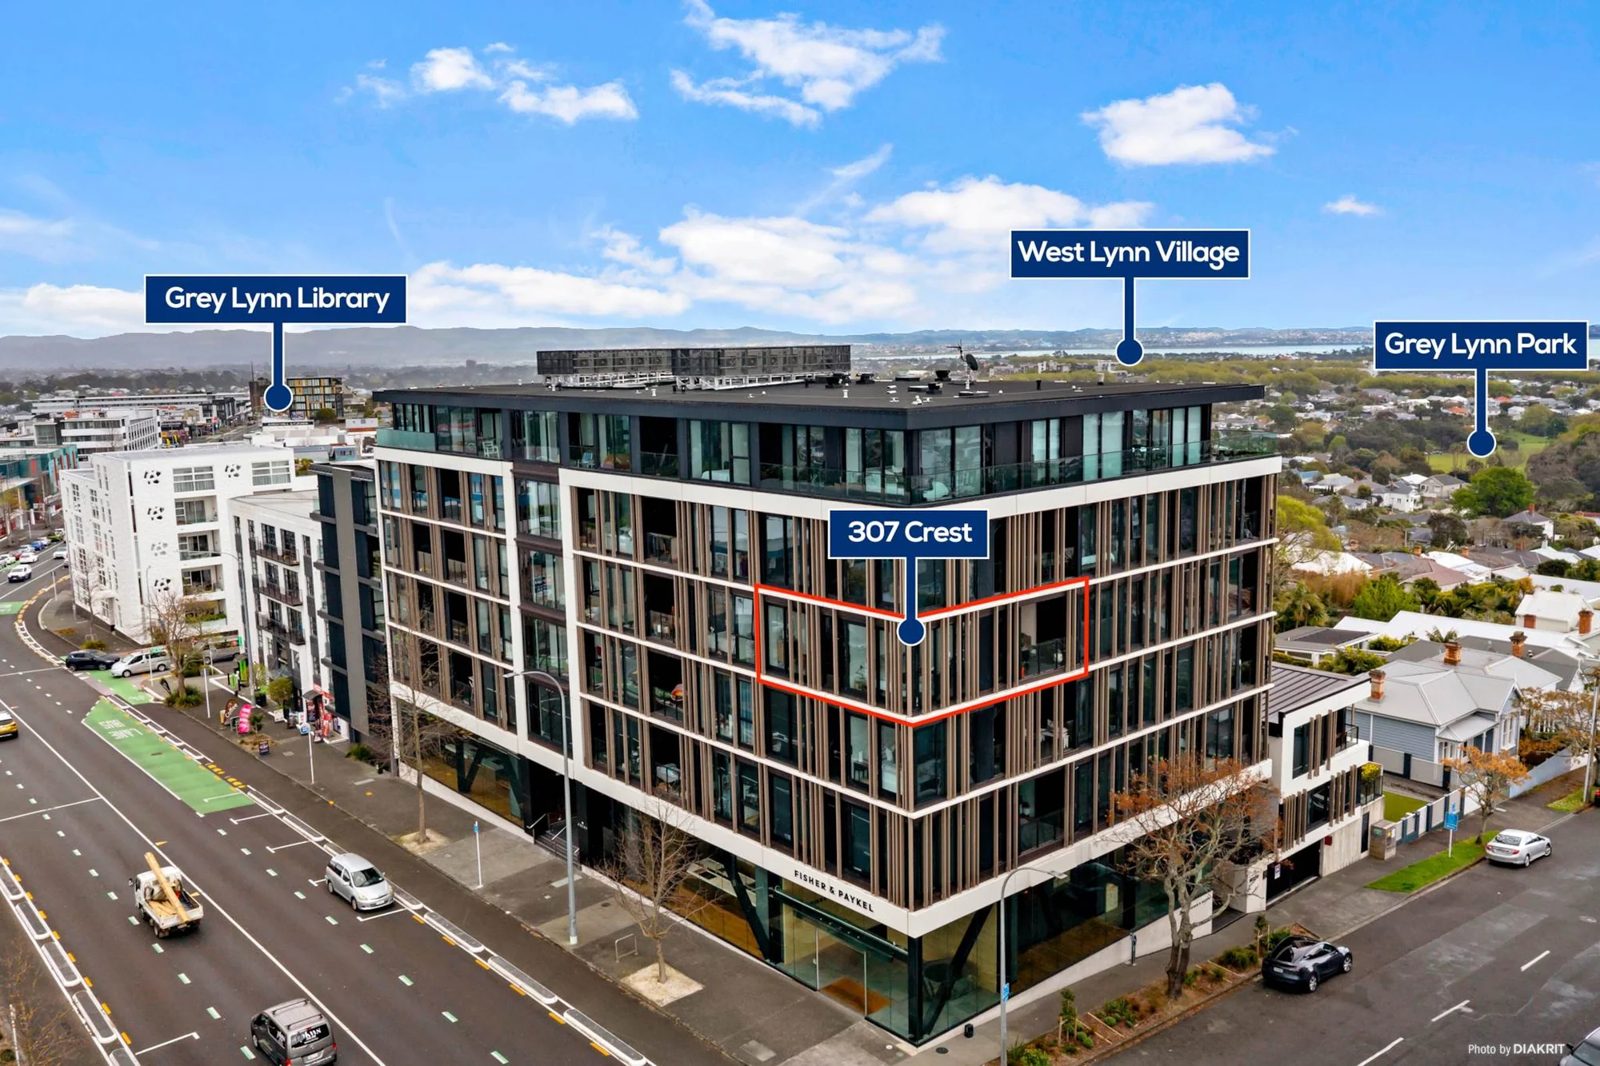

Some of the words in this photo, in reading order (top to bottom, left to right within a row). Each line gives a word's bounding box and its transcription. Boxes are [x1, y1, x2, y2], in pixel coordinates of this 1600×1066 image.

[794, 869, 827, 891] FISHER
[829, 885, 835, 895] &
[838, 889, 874, 913] PAYKEL
